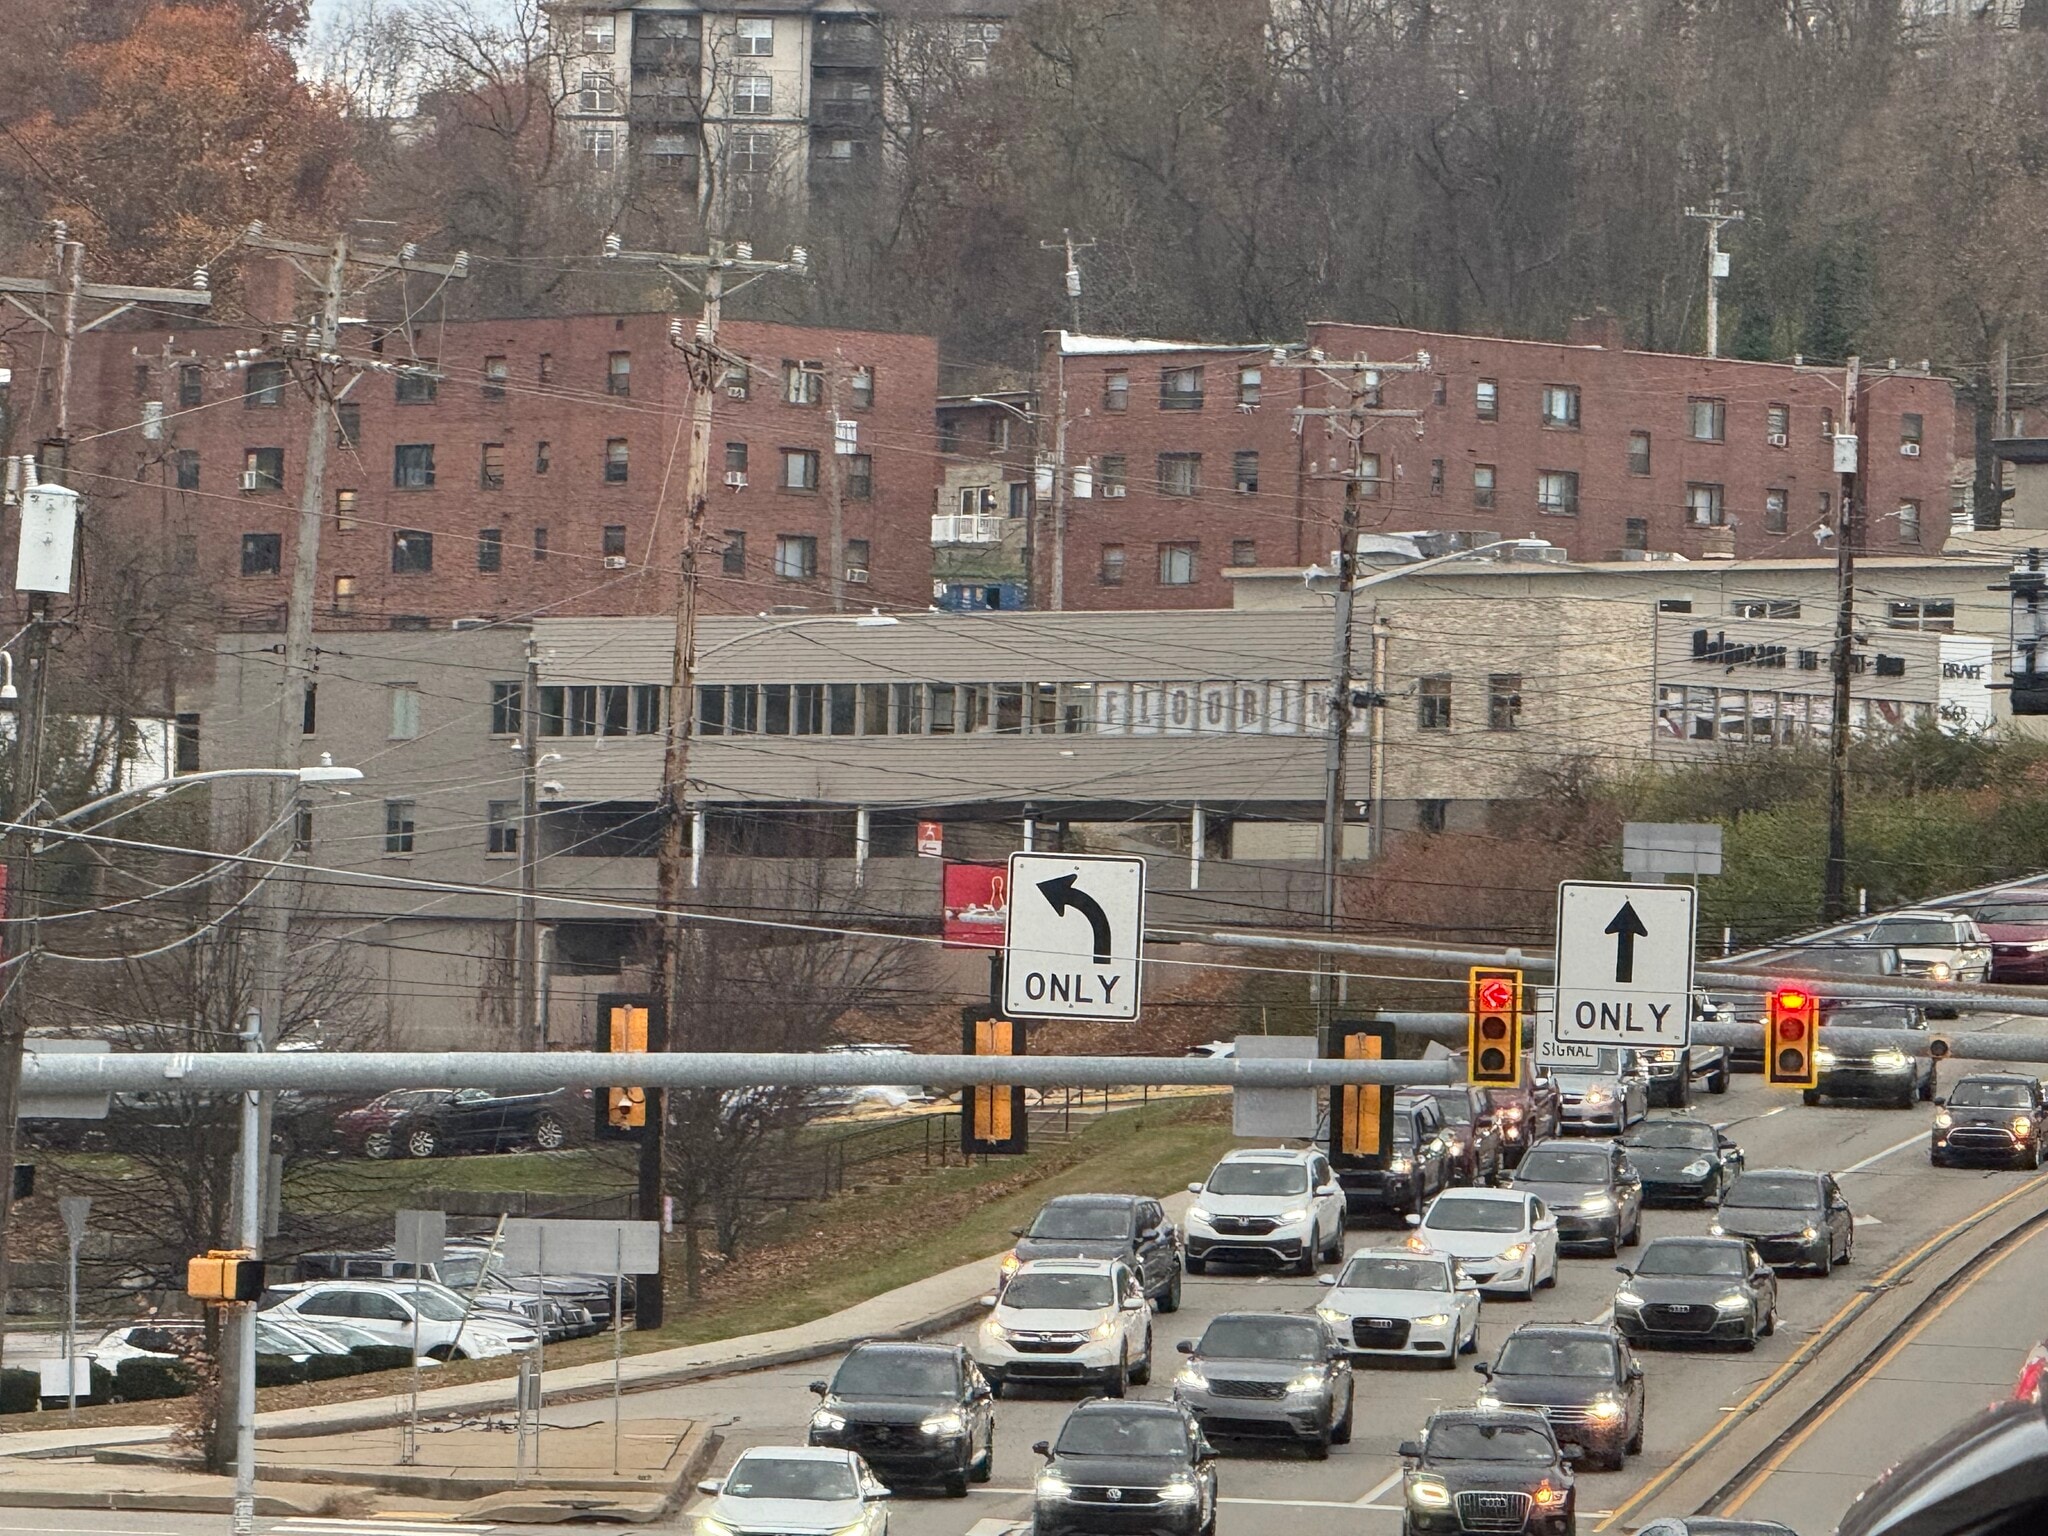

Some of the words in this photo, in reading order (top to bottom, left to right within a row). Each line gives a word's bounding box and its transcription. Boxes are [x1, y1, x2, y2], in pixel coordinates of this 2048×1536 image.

[1025, 972, 1121, 1004] ONLY
[1575, 1001, 1671, 1033] ONLY
[1542, 1041, 1594, 1058] SIGNAL
